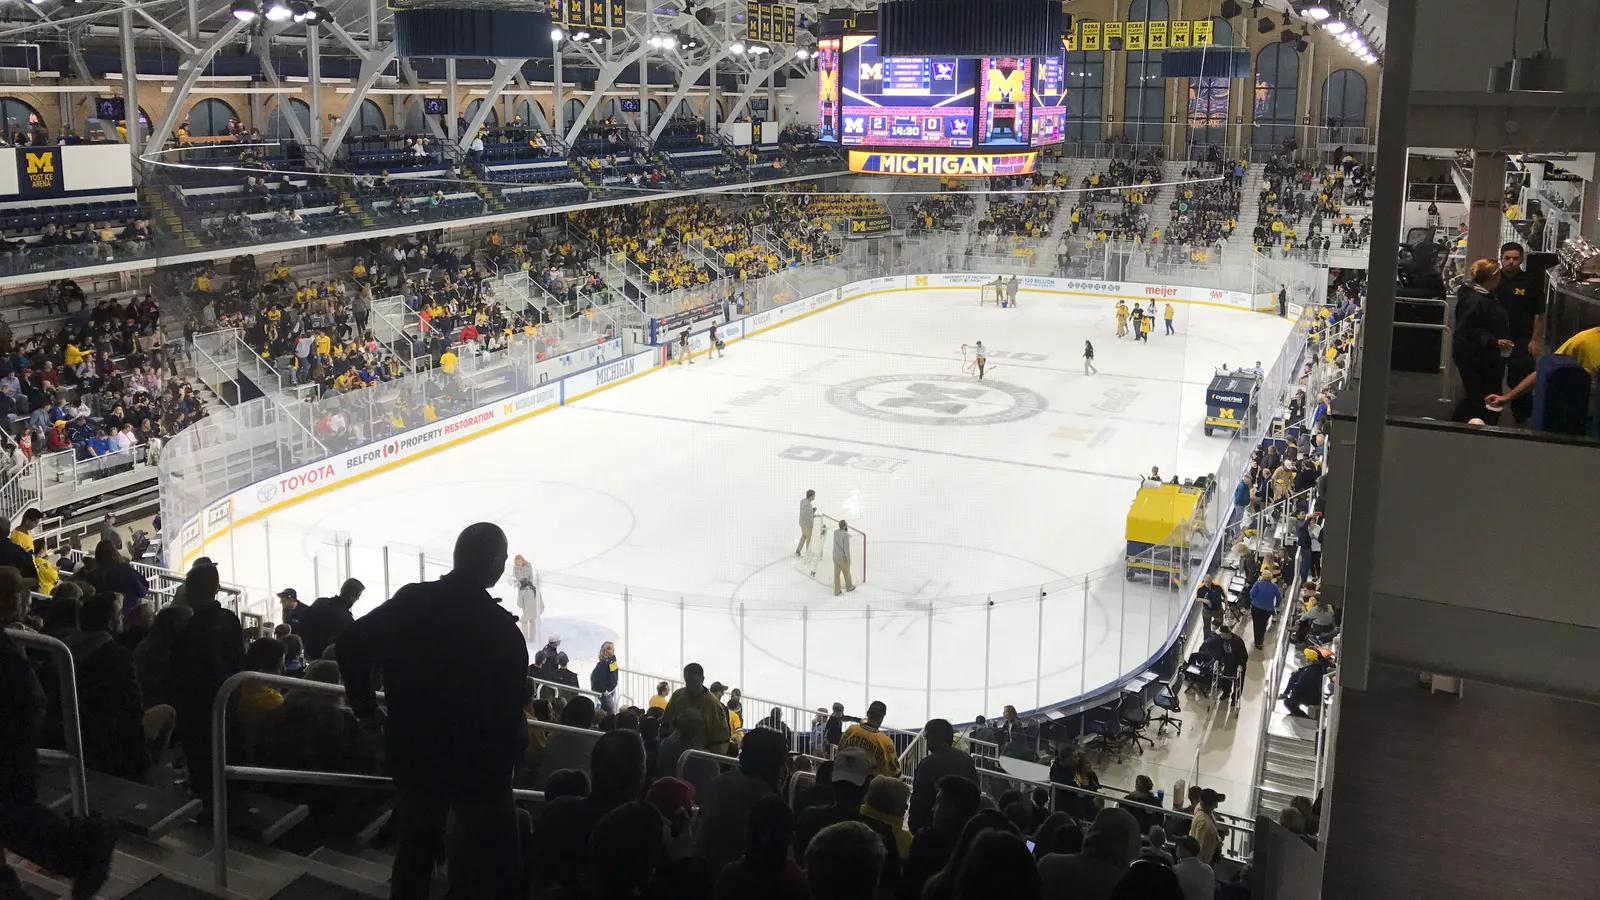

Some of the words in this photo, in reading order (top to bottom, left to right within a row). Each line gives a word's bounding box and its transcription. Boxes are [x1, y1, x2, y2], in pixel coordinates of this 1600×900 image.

[861, 63, 882, 80] M
[986, 69, 1025, 102] M
[845, 118, 864, 132] M
[874, 118, 882, 129] 2
[928, 119, 937, 129] 0
[891, 126, 919, 135] 14:30
[26, 152, 54, 173] M
[880, 155, 992, 174] MICHIGAN
[853, 221, 866, 232] M
[915, 276, 928, 285] M
[1145, 285, 1177, 297] meijer
[596, 358, 635, 385] MICHIGAN
[504, 403, 512, 415] M
[1220, 408, 1234, 419] M
[347, 449, 380, 469] BELFOR
[401, 428, 442, 450] PROPERTY
[444, 410, 494, 434] RESTORATION
[279, 464, 335, 493] TOYOTA
